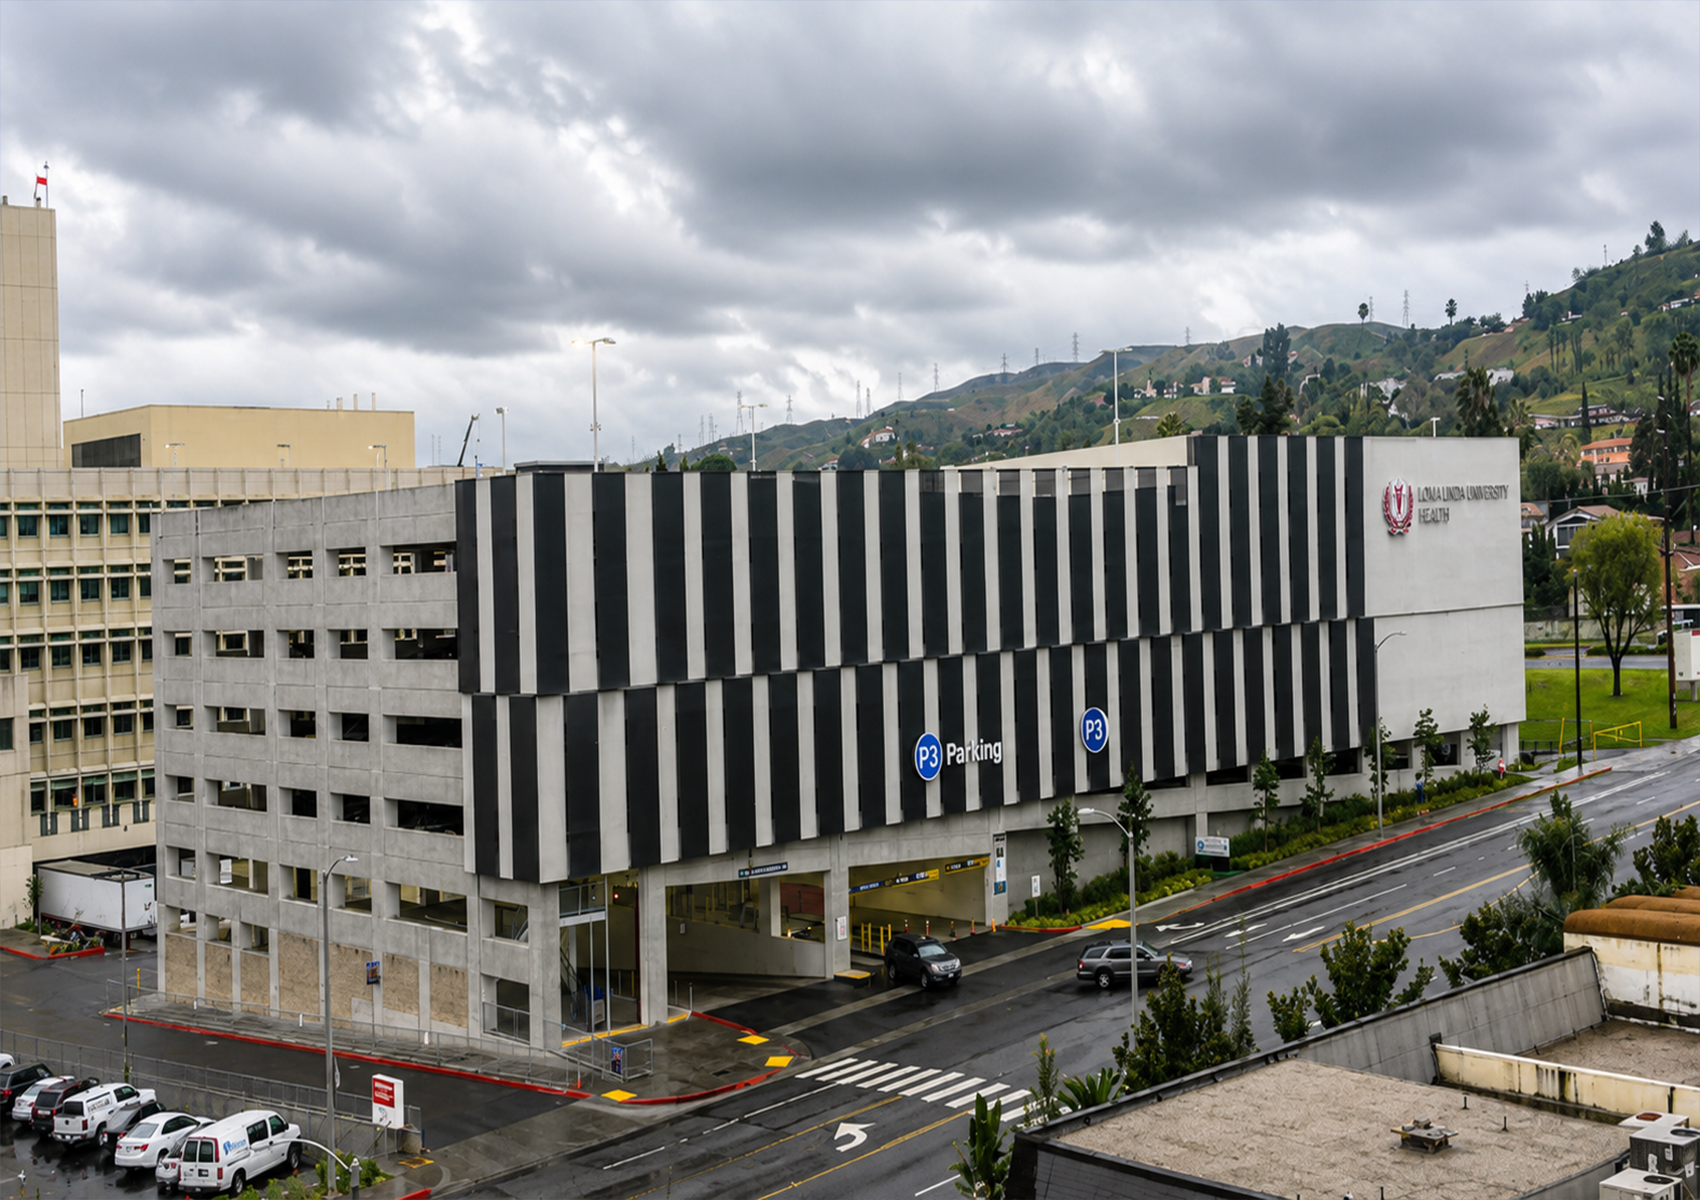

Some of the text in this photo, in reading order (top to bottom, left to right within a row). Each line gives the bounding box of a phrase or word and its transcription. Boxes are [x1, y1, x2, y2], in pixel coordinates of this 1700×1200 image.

[1417, 485, 1508, 502] LOMA LINDA UNIVERSITY
[1418, 507, 1449, 523] HEALTH
[1085, 719, 1103, 741] P3
[919, 738, 1002, 769] P3 Parking
